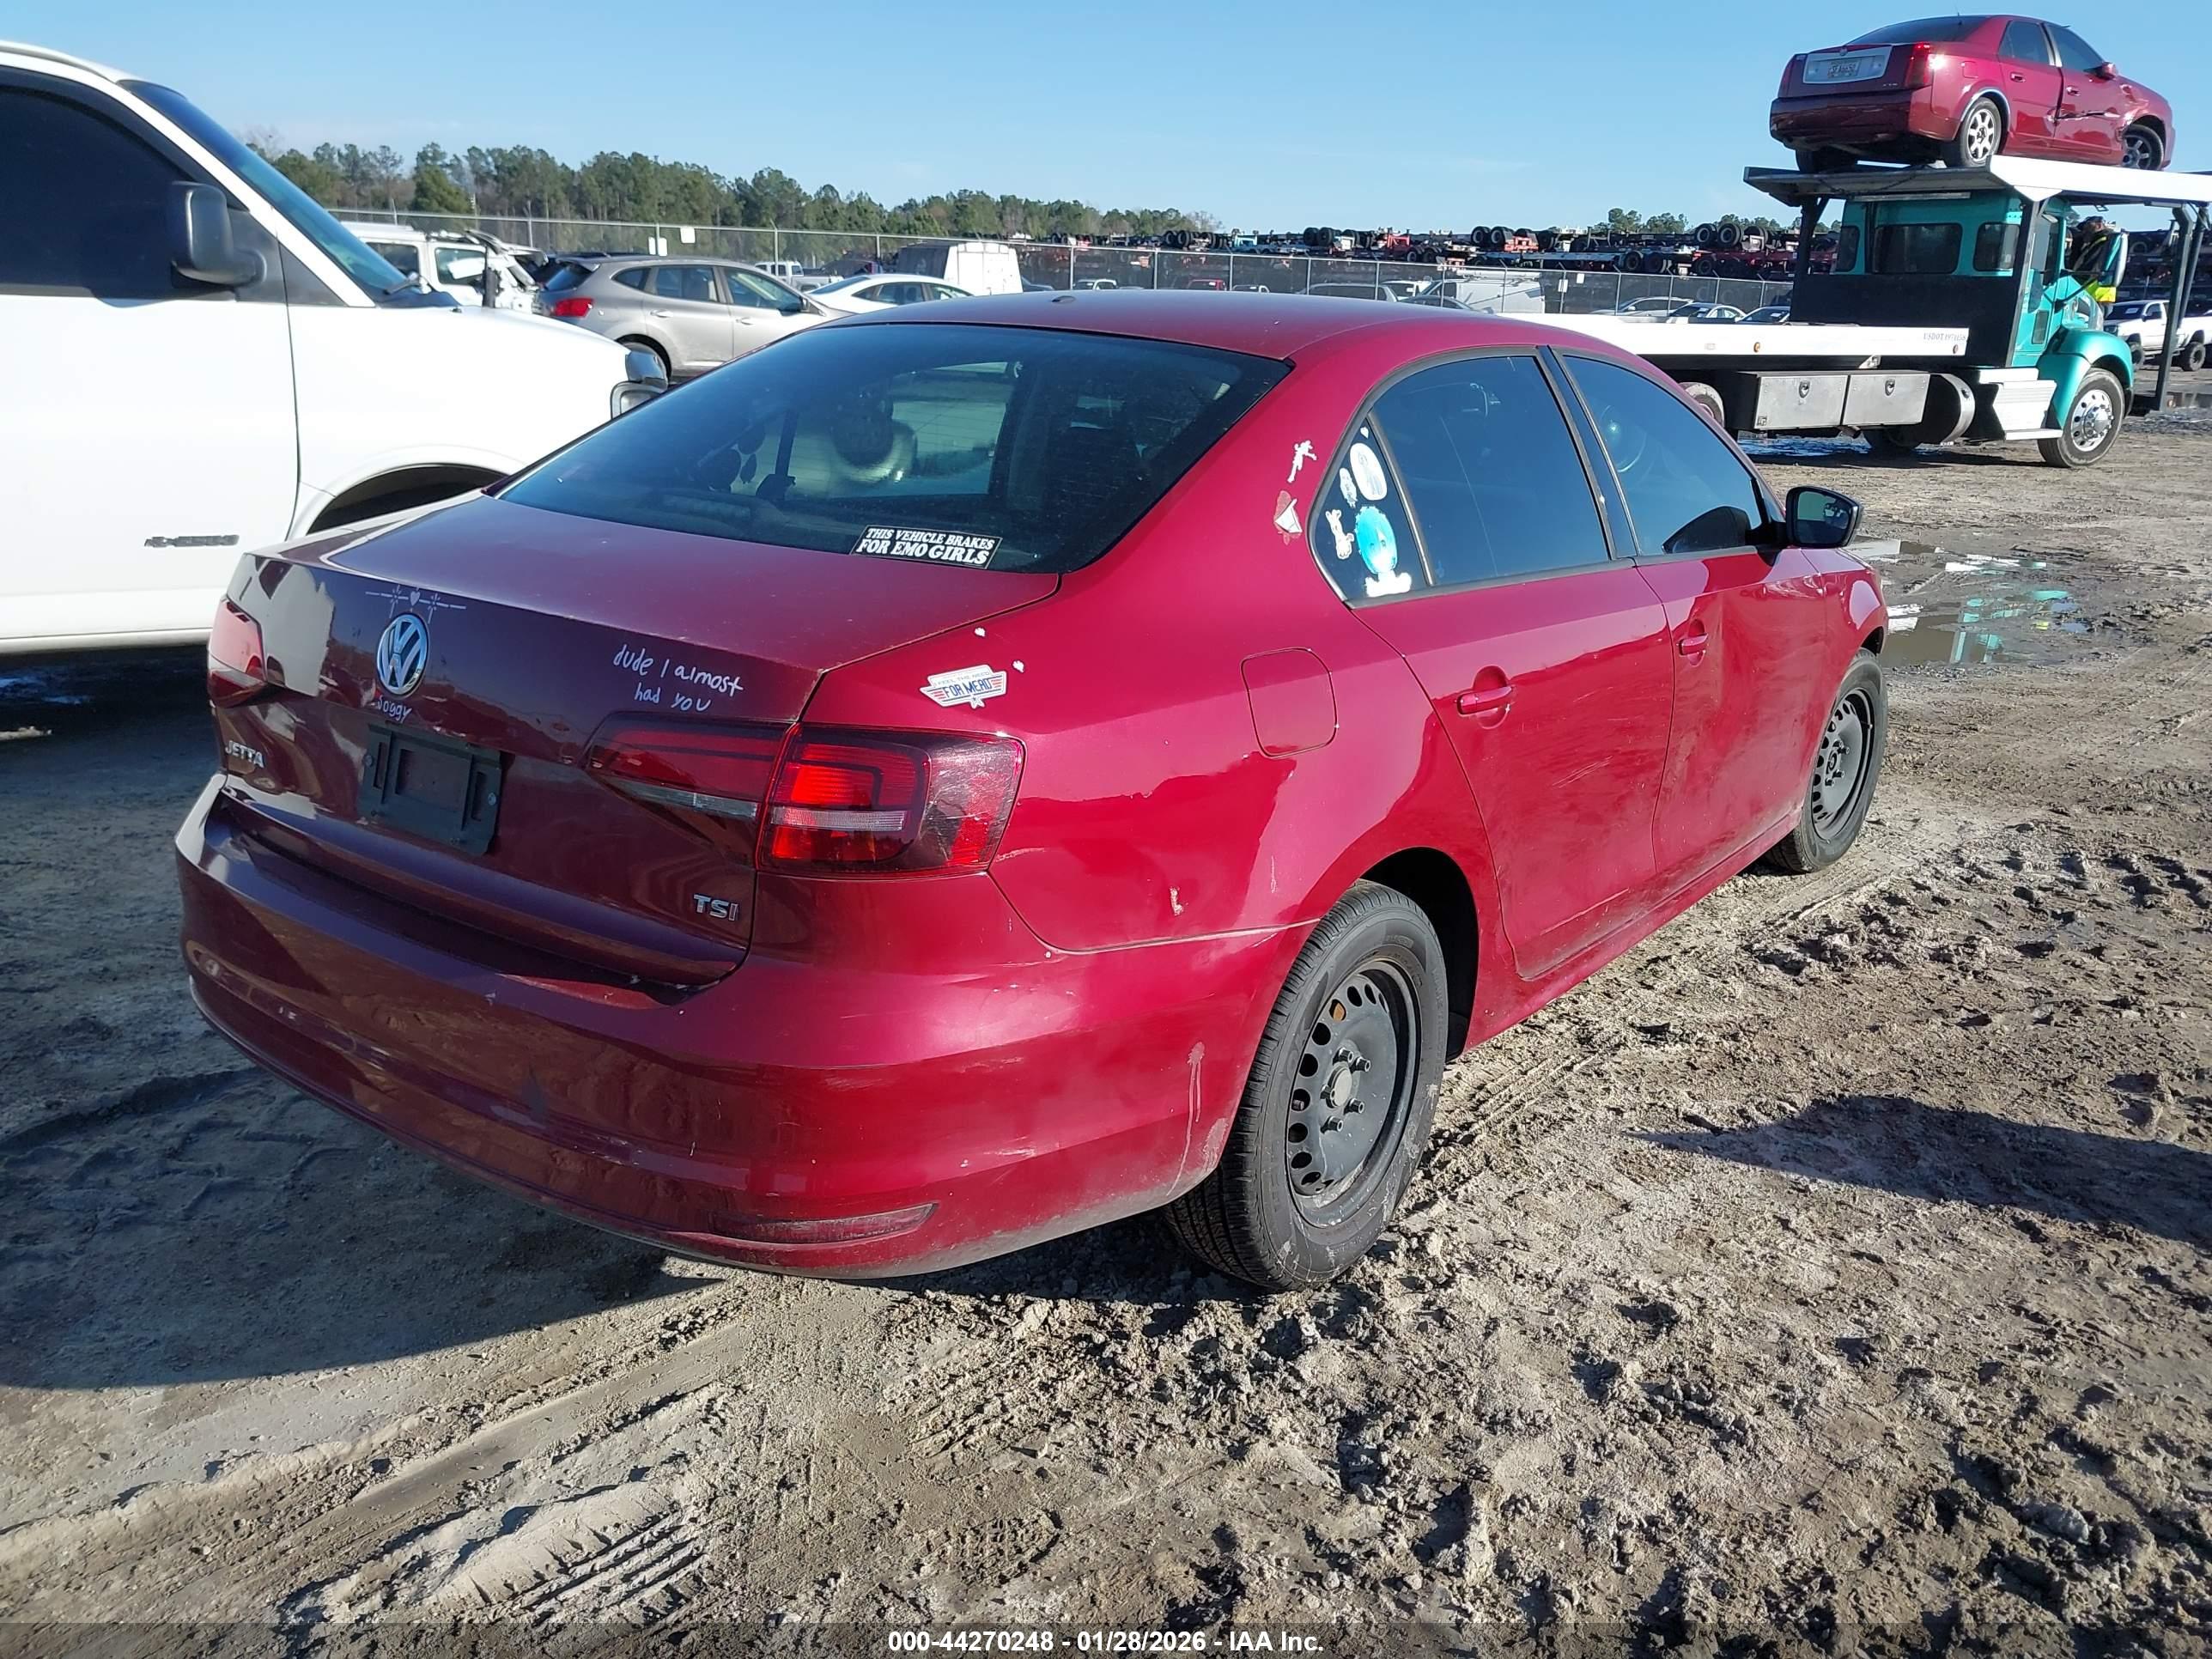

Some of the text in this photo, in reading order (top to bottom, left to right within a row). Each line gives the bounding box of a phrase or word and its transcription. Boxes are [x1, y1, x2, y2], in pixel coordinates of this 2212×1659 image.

[865, 527, 994, 550] THIS VEHICLE BRAKES
[856, 539, 990, 565] FOR EMO GIRLS
[612, 643, 654, 677] dude
[673, 665, 745, 698] almost
[633, 681, 662, 705] had
[944, 684, 965, 697] FOR
[225, 740, 264, 768] JETTA
[693, 894, 738, 921] TSI
